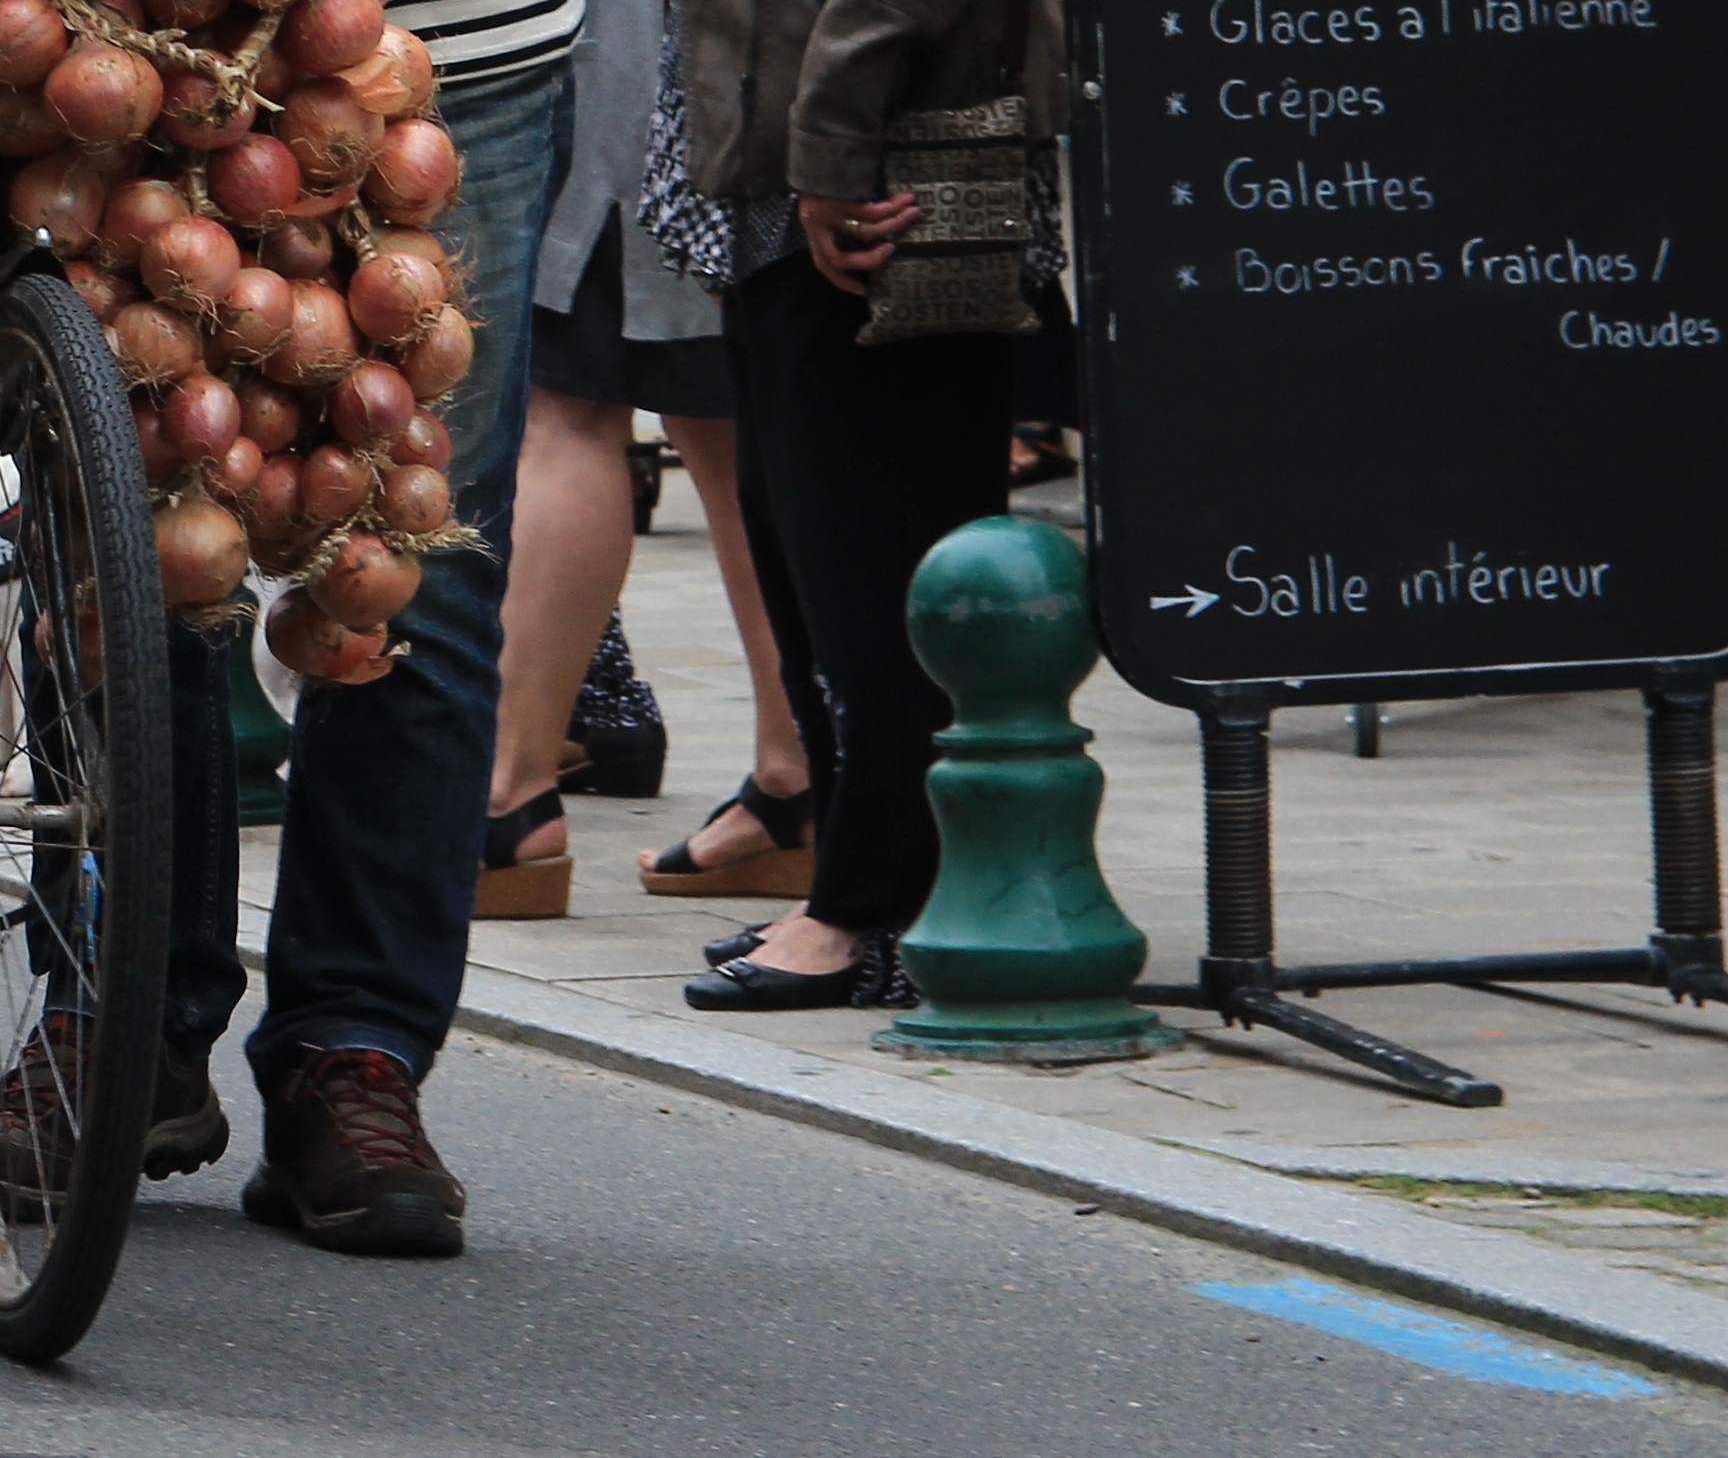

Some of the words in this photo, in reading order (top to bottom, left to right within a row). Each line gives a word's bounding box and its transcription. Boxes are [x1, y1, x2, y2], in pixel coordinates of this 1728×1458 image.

[1219, 78, 1386, 136] Crêpes
[1223, 157, 1435, 211] Galettes
[1235, 248, 1443, 294] Boissons
[1560, 310, 1721, 349] Chaudes
[1225, 545, 1369, 617] Salle
[1400, 541, 1611, 607] intérieur
